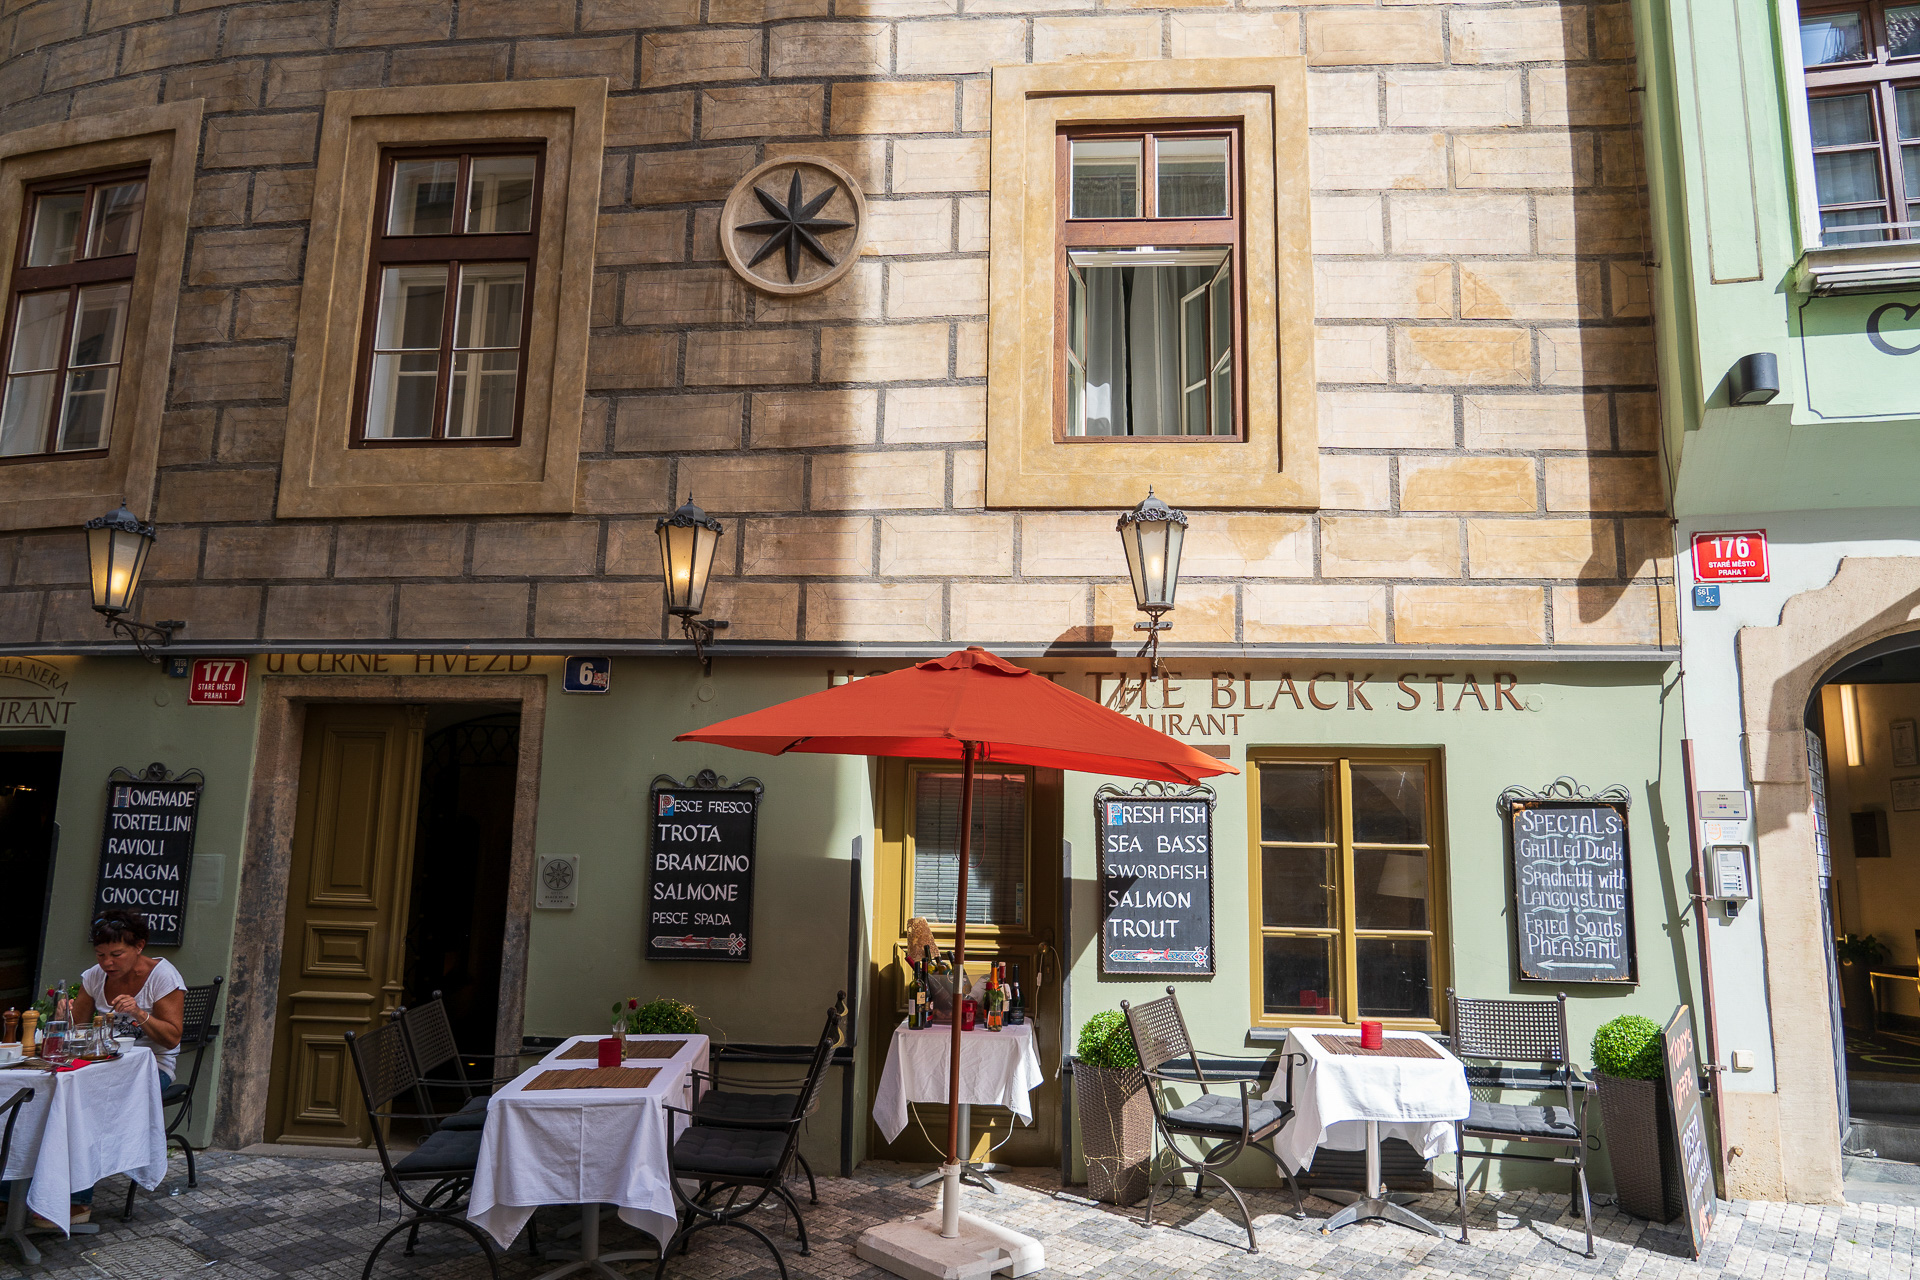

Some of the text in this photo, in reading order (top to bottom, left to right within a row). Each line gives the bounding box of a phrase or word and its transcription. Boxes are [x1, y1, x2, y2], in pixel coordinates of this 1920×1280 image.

[1710, 536, 1750, 559] 176
[1708, 559, 1756, 568] STARÉ MĚSTO
[27, 663, 69, 697] NERA
[203, 661, 236, 682] 177
[579, 661, 594, 686] 6
[198, 682, 215, 691] STARÉ
[1085, 671, 1525, 712] THE BLACK STAR
[113, 787, 196, 808] HOMEMADE
[658, 794, 753, 816] PESCE FRESCO
[112, 813, 192, 832] TORTELLINI
[1107, 803, 1207, 825] FRESH FISH
[1521, 809, 1623, 835] SPECIALS:
[658, 823, 722, 842] TROTA
[108, 838, 164, 856] RAVIOLI
[1107, 834, 1208, 854] SEA BASS
[1584, 840, 1623, 861] Duck
[104, 862, 180, 881] LASAGNA
[655, 853, 749, 872] BRANZINO
[1108, 863, 1208, 880] SWORDFISH
[1597, 868, 1627, 890] with
[101, 886, 179, 906] GNOCCHI
[653, 882, 738, 901] SALMONE
[1108, 890, 1191, 909] SALMON
[652, 912, 732, 926] PESCE SPADA
[1108, 918, 1180, 938] TROUT
[1669, 1027, 1693, 1072] TODAY'S
[1675, 1066, 1693, 1111] OFFER
